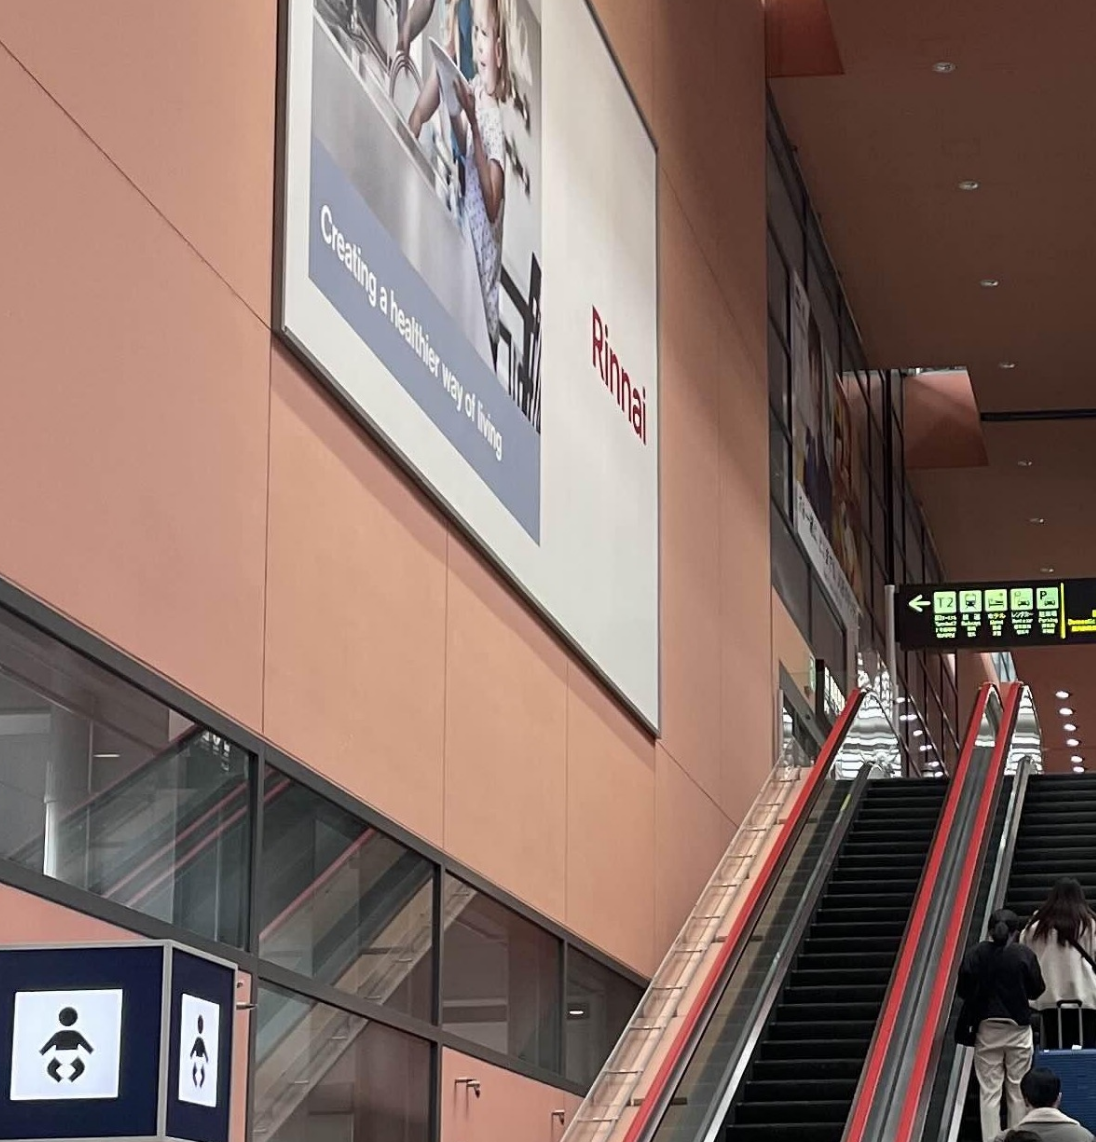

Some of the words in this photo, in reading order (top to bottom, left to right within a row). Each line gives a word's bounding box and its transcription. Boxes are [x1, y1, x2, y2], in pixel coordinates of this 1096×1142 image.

[320, 204, 377, 307] Creating
[380, 286, 388, 315] a
[390, 290, 441, 378] healthier
[442, 363, 464, 411] way
[464, 392, 477, 422] of
[478, 400, 503, 461] living
[592, 304, 647, 445] Rinnai
